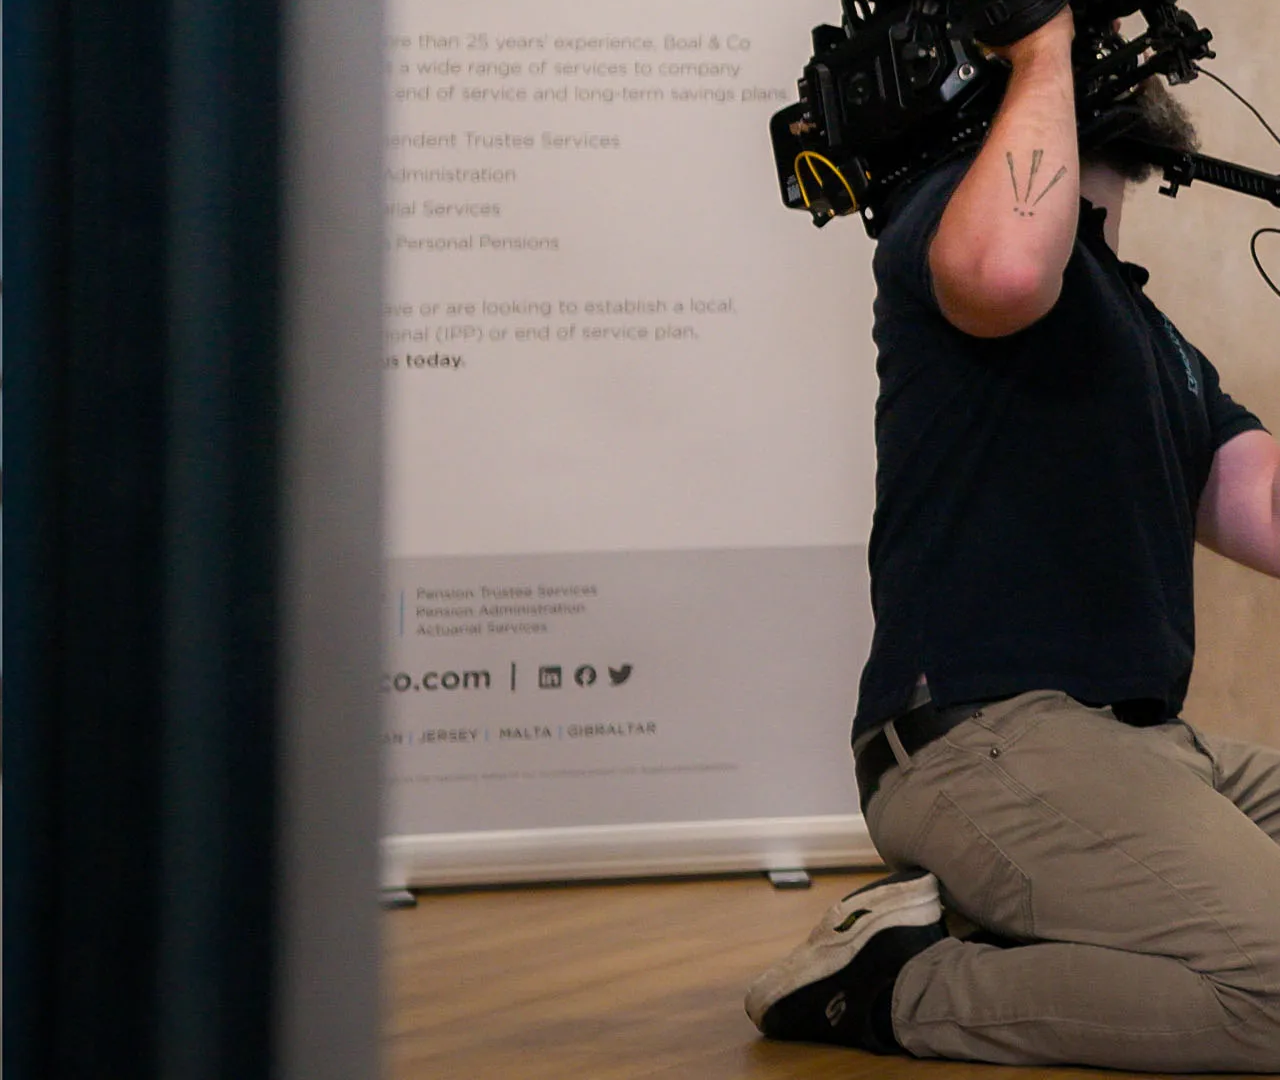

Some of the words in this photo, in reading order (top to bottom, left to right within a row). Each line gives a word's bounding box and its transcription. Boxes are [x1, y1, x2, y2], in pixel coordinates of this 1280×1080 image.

[418, 33, 459, 49] than
[467, 33, 489, 50] 25
[664, 33, 702, 51] Boal
[708, 34, 720, 50] &
[726, 34, 751, 50] Co
[416, 59, 462, 75] wide
[468, 62, 522, 78] range
[528, 60, 548, 75] of
[554, 61, 628, 77] services
[635, 61, 652, 76] to
[659, 62, 742, 79] company
[436, 86, 455, 101] of
[462, 86, 528, 102] service
[533, 86, 568, 102] and
[574, 86, 664, 103] long-term
[671, 87, 735, 103] savings
[466, 131, 535, 149] Trustee
[541, 131, 621, 149] Services
[423, 200, 502, 217] Services
[395, 234, 474, 251] Personal
[479, 234, 560, 251] Pensions
[419, 302, 440, 317] or
[446, 302, 476, 316] are
[482, 300, 552, 318] looking
[559, 301, 578, 314] to
[584, 298, 667, 315] establish
[673, 302, 684, 314] a
[488, 328, 508, 342] or
[514, 326, 550, 341] end
[556, 324, 576, 341] of
[581, 324, 649, 340] service
[416, 587, 475, 601] Pension
[481, 585, 533, 600] Trustee
[537, 584, 598, 599] Services
[416, 605, 475, 618] Pension
[479, 603, 587, 618] Administration
[487, 622, 548, 635] Services
[419, 728, 479, 744] JERSEY
[499, 726, 553, 741] MALTA
[567, 721, 657, 738] GIBRALTAR
